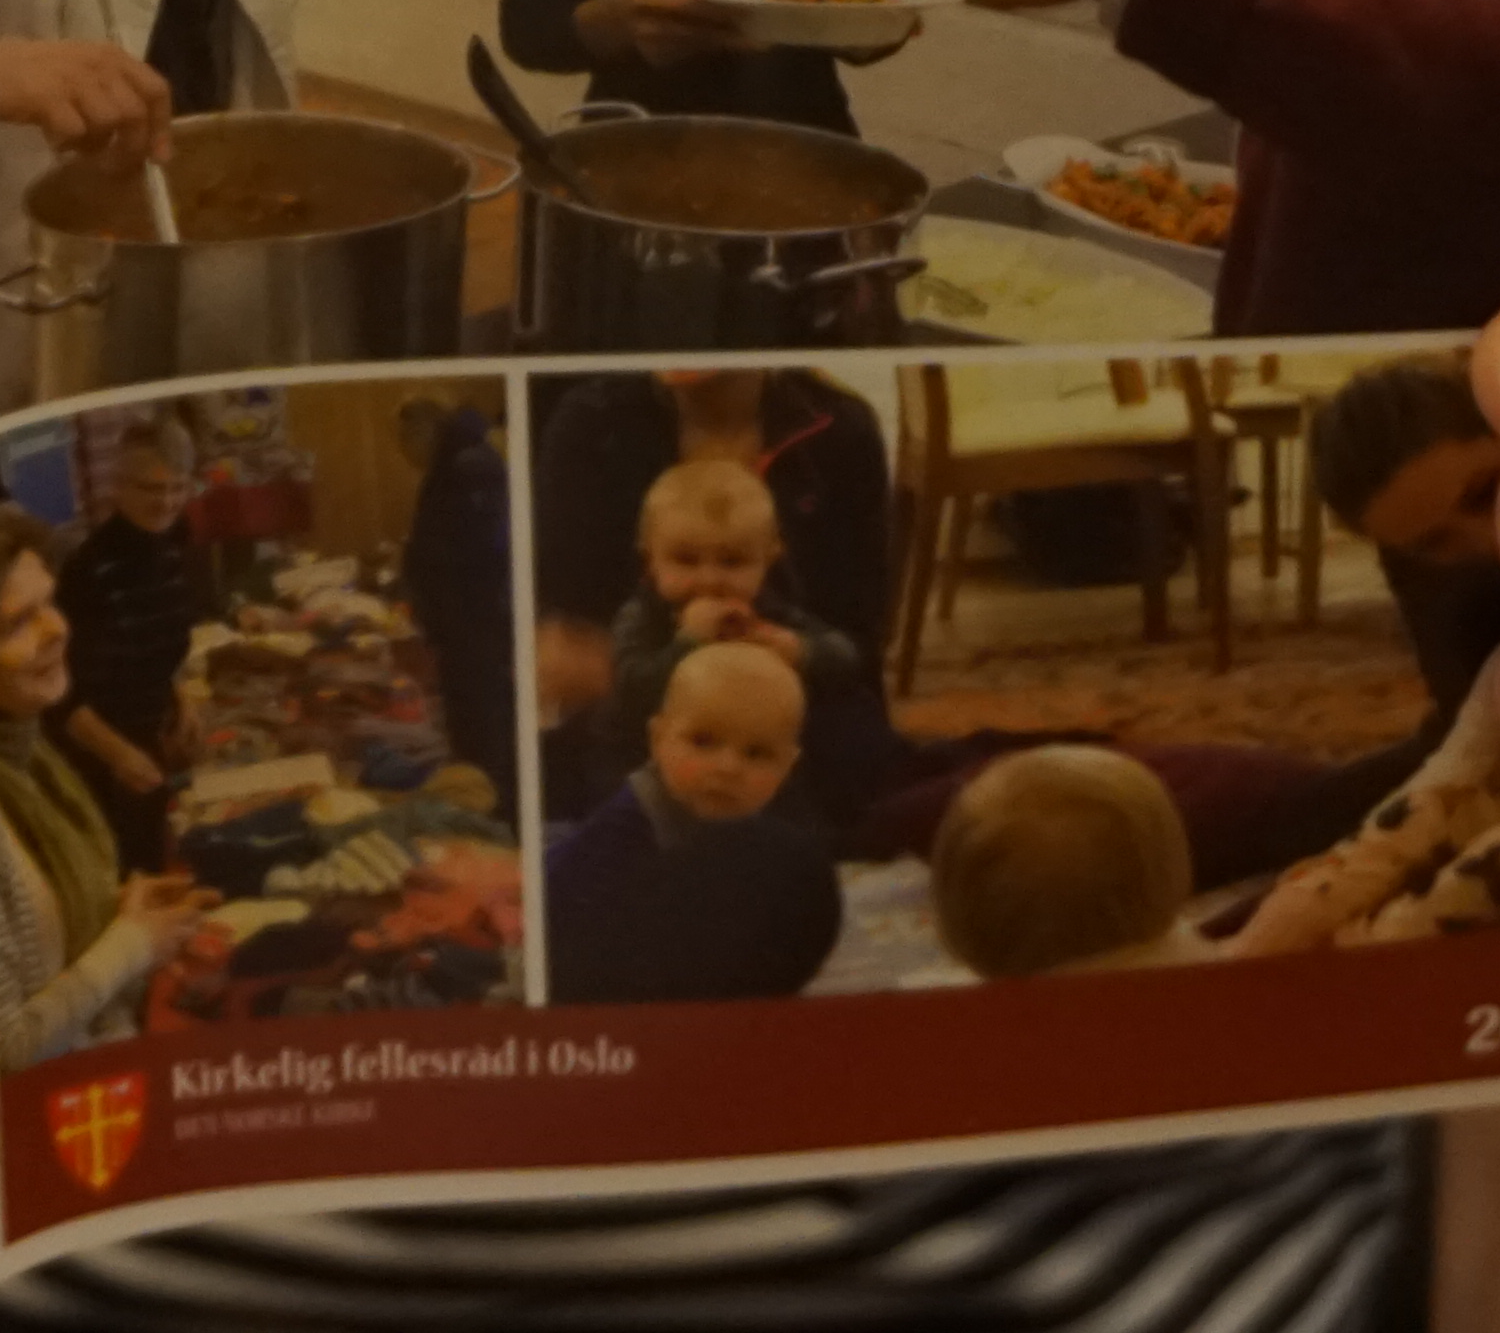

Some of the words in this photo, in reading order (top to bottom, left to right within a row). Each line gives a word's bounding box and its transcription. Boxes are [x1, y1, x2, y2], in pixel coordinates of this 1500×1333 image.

[172, 1046, 335, 1102] Kirkelig
[341, 1037, 516, 1082] fellesråd
[527, 1037, 539, 1076] i
[549, 1033, 635, 1077] Oslo
